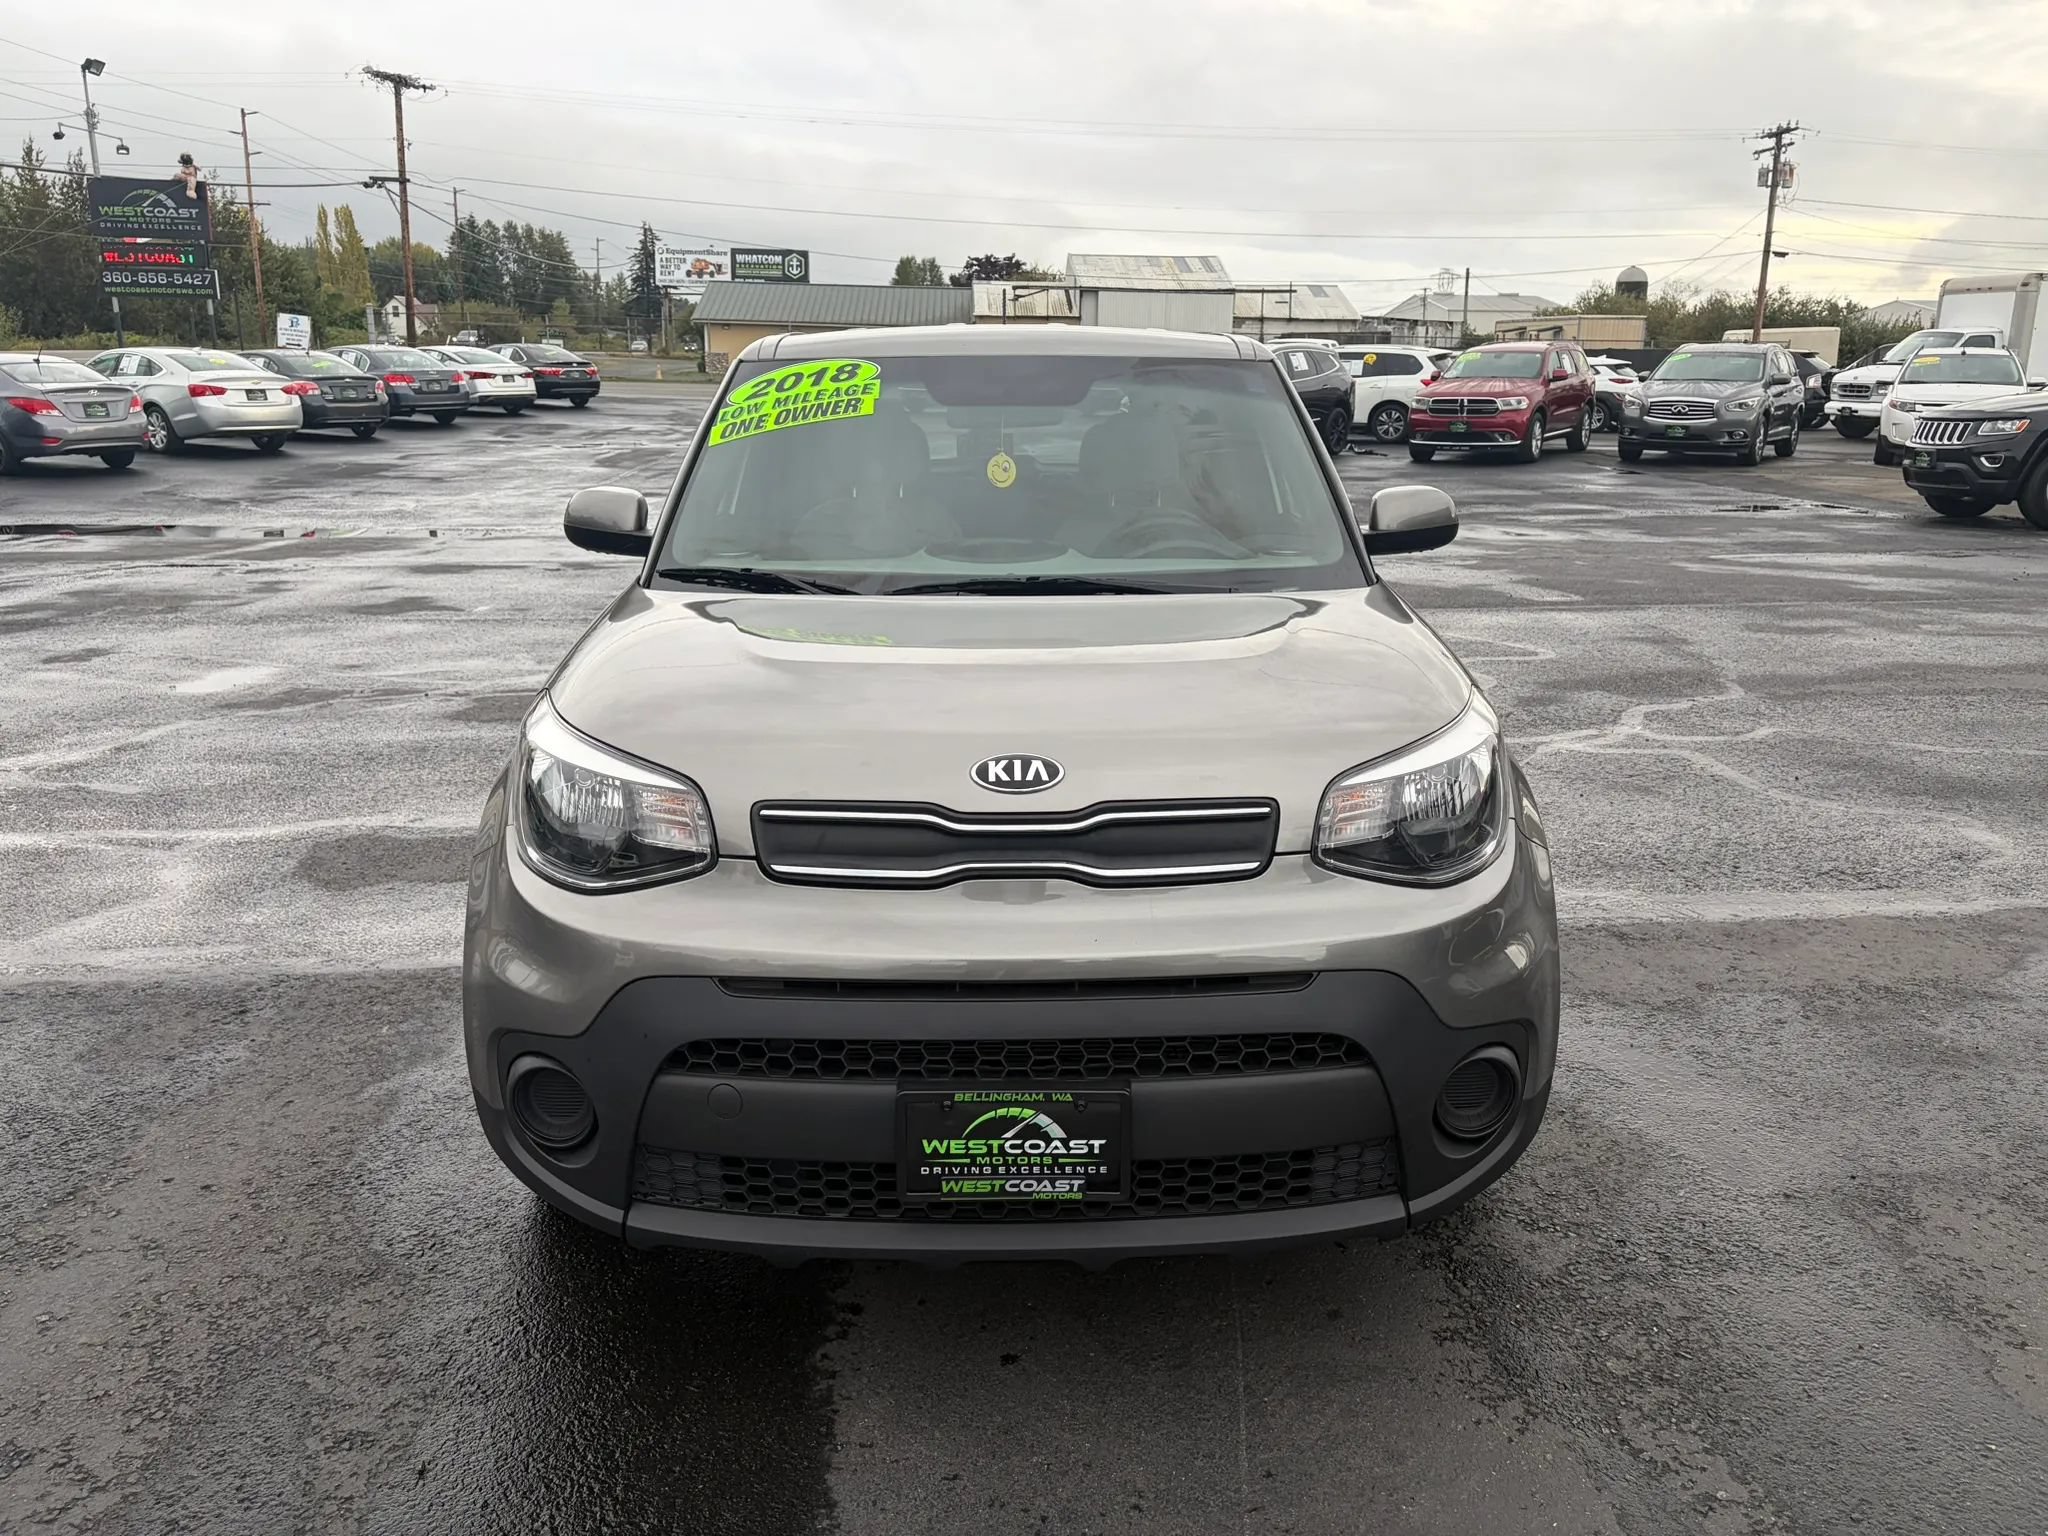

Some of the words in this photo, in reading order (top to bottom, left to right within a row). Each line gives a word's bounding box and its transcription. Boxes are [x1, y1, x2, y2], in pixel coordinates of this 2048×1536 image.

[98, 206, 199, 218] WESTCOAST
[142, 223, 202, 231] EXCELLENCE
[665, 248, 728, 257] EquipmentShare
[735, 254, 783, 264] WHATCOM
[102, 271, 211, 285] 360-656-5427
[104, 286, 214, 295] westcoastmotorswa.com
[744, 363, 862, 401] 2018
[719, 401, 766, 422] LOW
[772, 382, 876, 411] MILEAGE
[719, 413, 771, 440] ONE
[987, 759, 1050, 782] KIA
[1051, 1093, 1074, 1102] WA
[921, 1139, 1107, 1154] WESTCOAST
[976, 1156, 1053, 1165] MOTORS
[920, 1166, 993, 1175] DRIVING
[998, 1166, 1108, 1174] EXCELLENCE
[940, 1179, 1086, 1193] WESTCOAST
[1032, 1192, 1083, 1200] MOTORS
